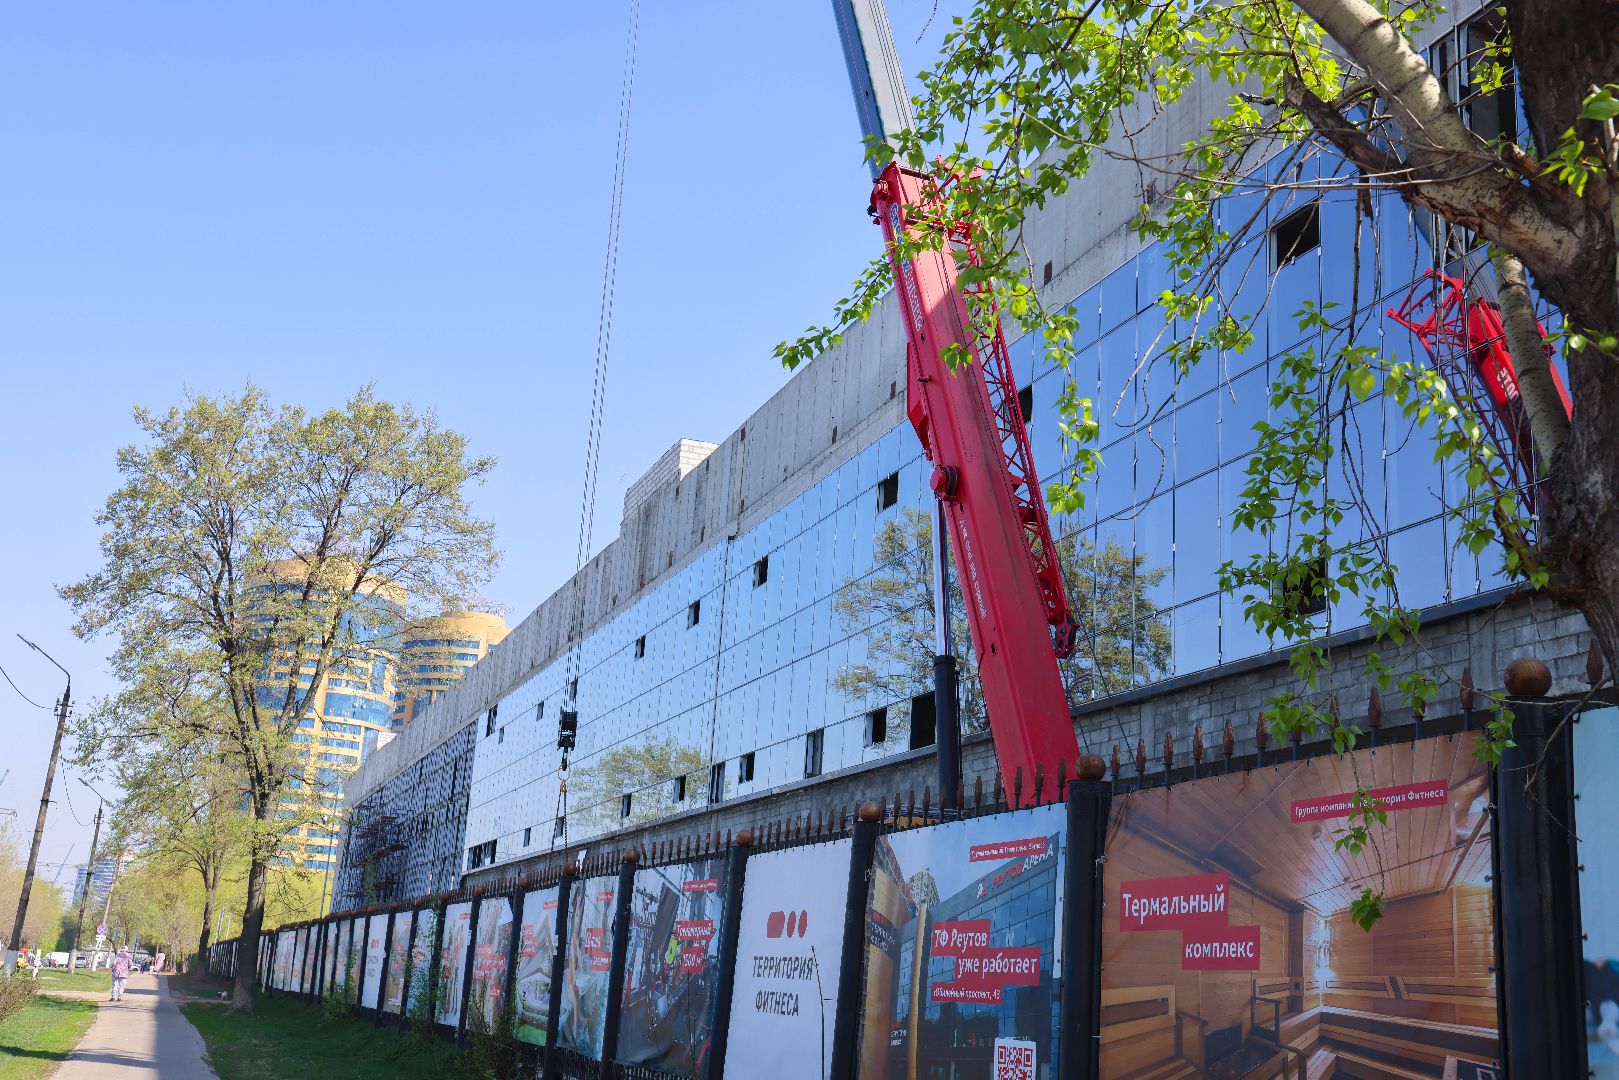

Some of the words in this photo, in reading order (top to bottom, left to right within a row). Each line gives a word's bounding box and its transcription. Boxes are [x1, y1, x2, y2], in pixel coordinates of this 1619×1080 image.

[1295, 806, 1319, 817] Группа
[1320, 801, 1356, 812] компани
[1359, 795, 1406, 808] ертория
[1407, 789, 1445, 800] Фитнеса
[1122, 884, 1225, 925] Термальный
[934, 929, 949, 948] ТФ
[950, 928, 988, 954] Реутов
[1185, 941, 1254, 958] комплекс
[753, 956, 813, 980] ТЕРРИТОРИЯ
[958, 958, 980, 979] уже
[982, 952, 1038, 979] работает
[755, 990, 799, 1016] ФИТНЕСА
